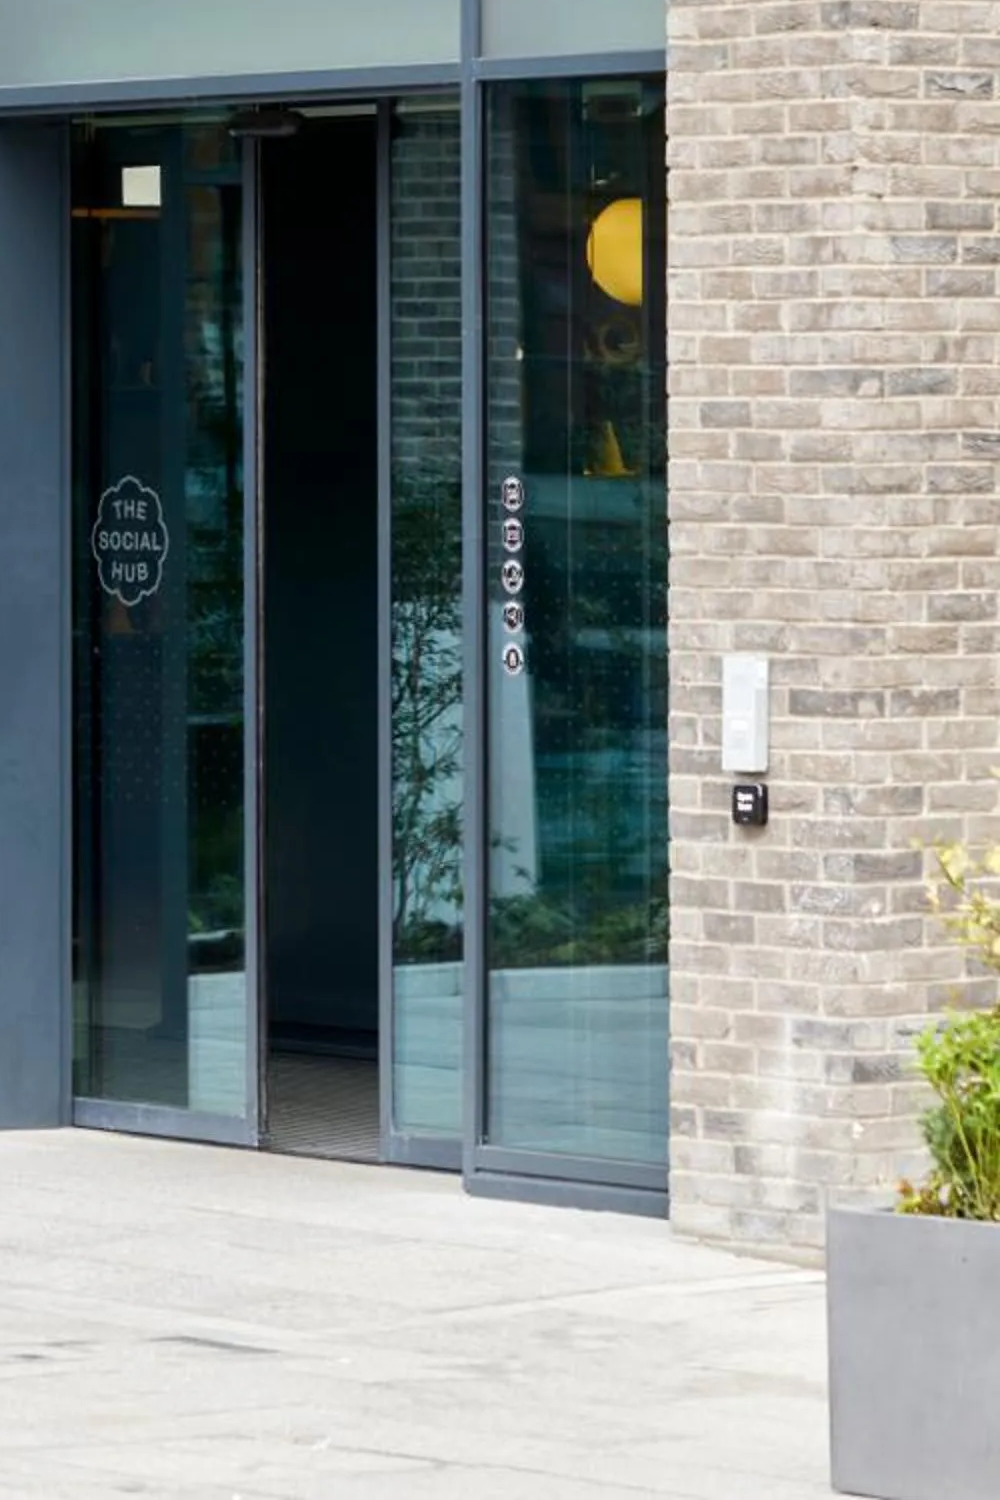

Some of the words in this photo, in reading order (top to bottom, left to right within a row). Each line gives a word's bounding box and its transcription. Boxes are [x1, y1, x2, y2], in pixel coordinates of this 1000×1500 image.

[111, 499, 148, 521] THE
[98, 530, 162, 551] SOCIAL
[110, 561, 150, 583] HUB
